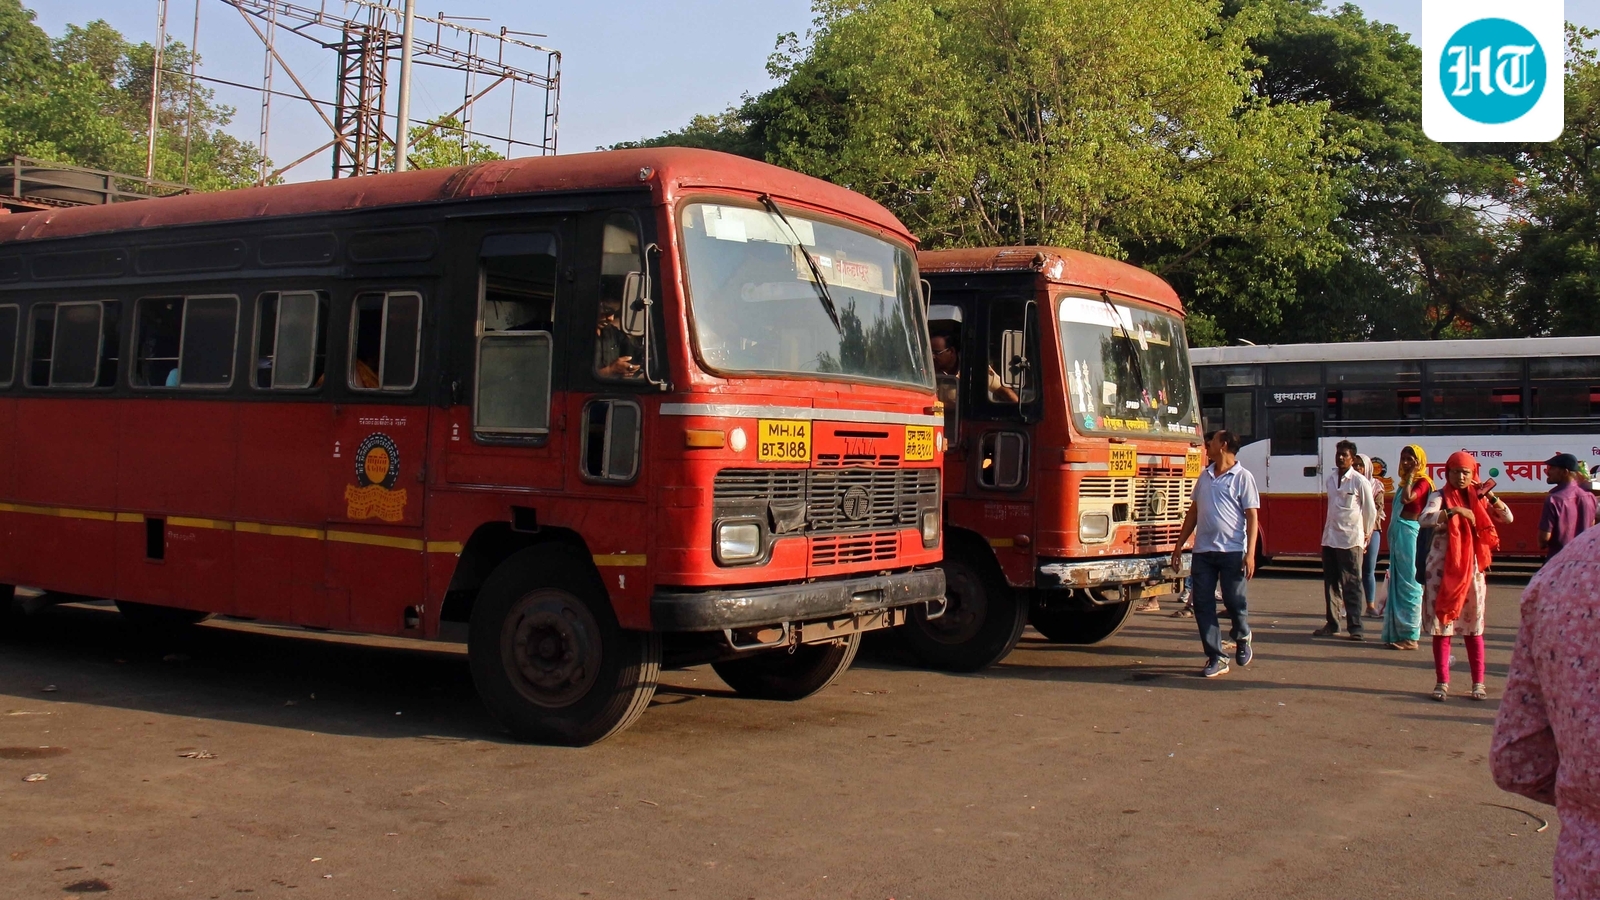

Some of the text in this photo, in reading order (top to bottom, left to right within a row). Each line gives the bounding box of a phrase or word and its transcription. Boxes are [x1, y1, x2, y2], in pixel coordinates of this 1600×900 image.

[768, 423, 806, 439] MH.14
[761, 441, 807, 458] BT.3188
[1480, 450, 1502, 458] वाहक
